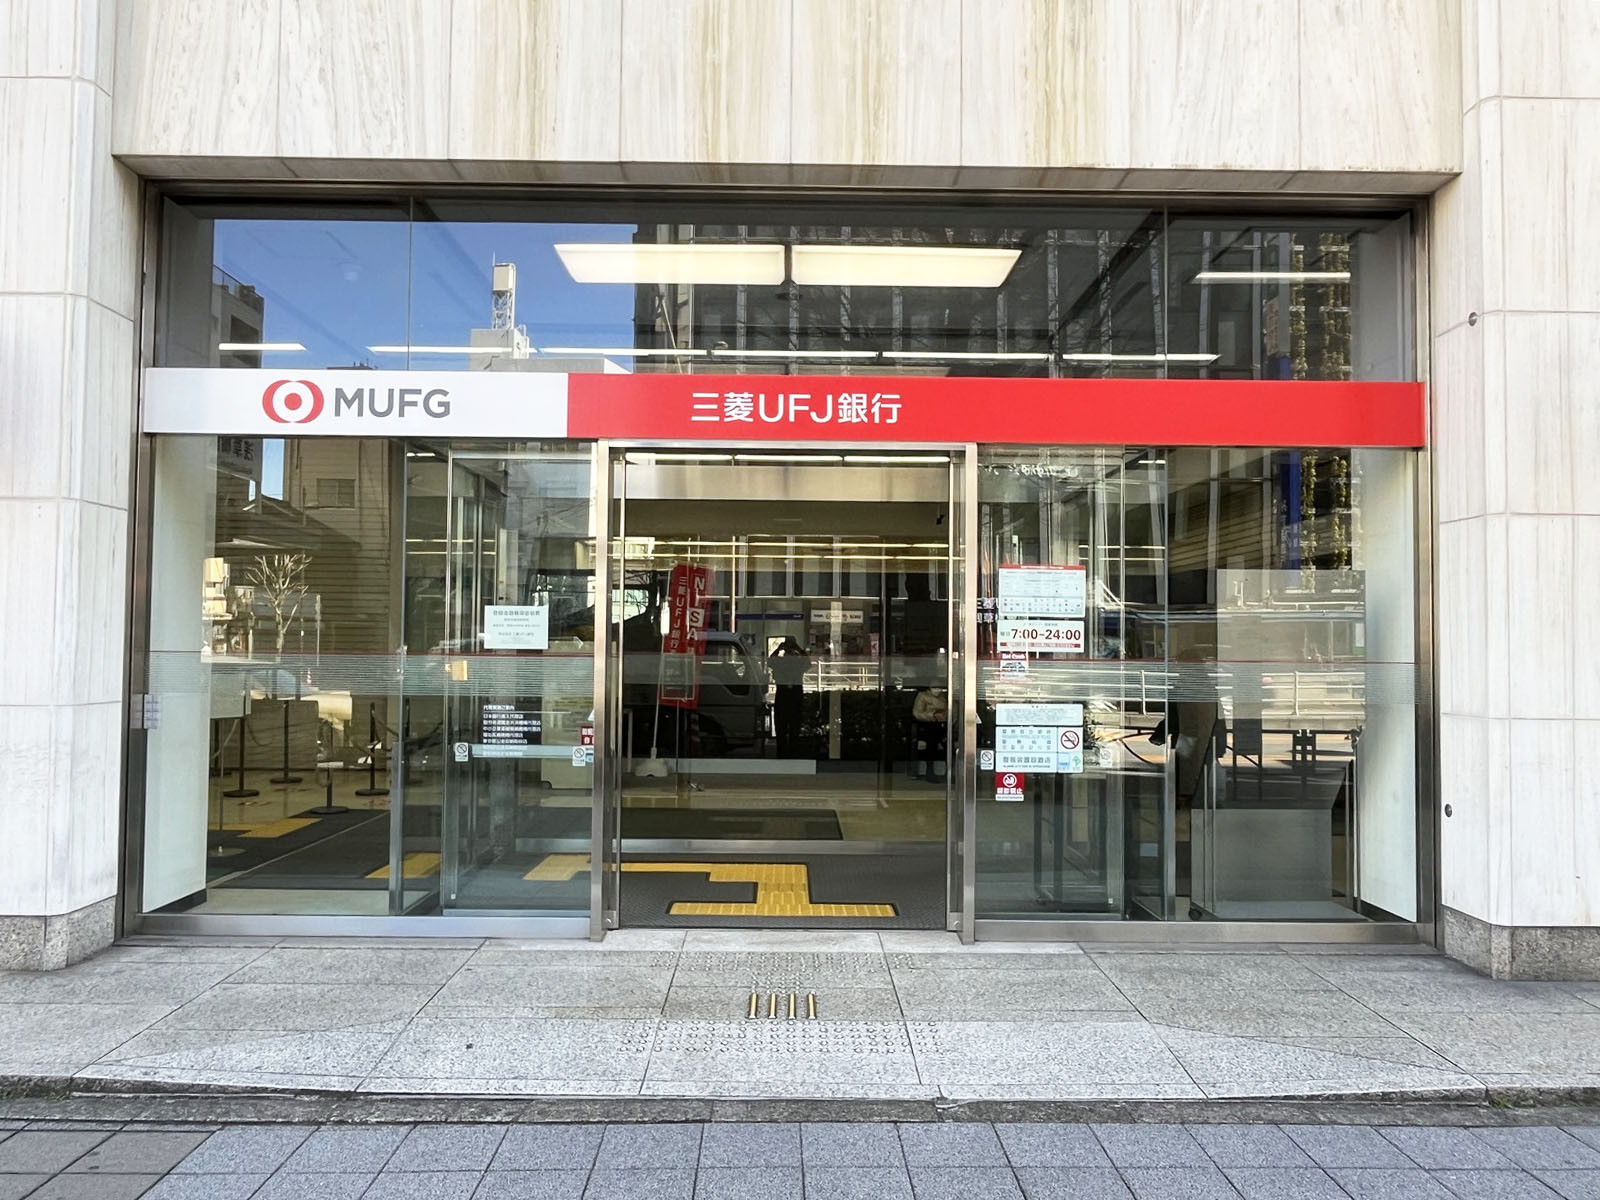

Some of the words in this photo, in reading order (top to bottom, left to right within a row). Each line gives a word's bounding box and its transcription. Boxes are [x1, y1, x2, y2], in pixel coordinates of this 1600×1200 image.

[334, 388, 450, 418] MUFG
[691, 392, 902, 424] 三菱UFJ銀行
[687, 576, 705, 641] NISA
